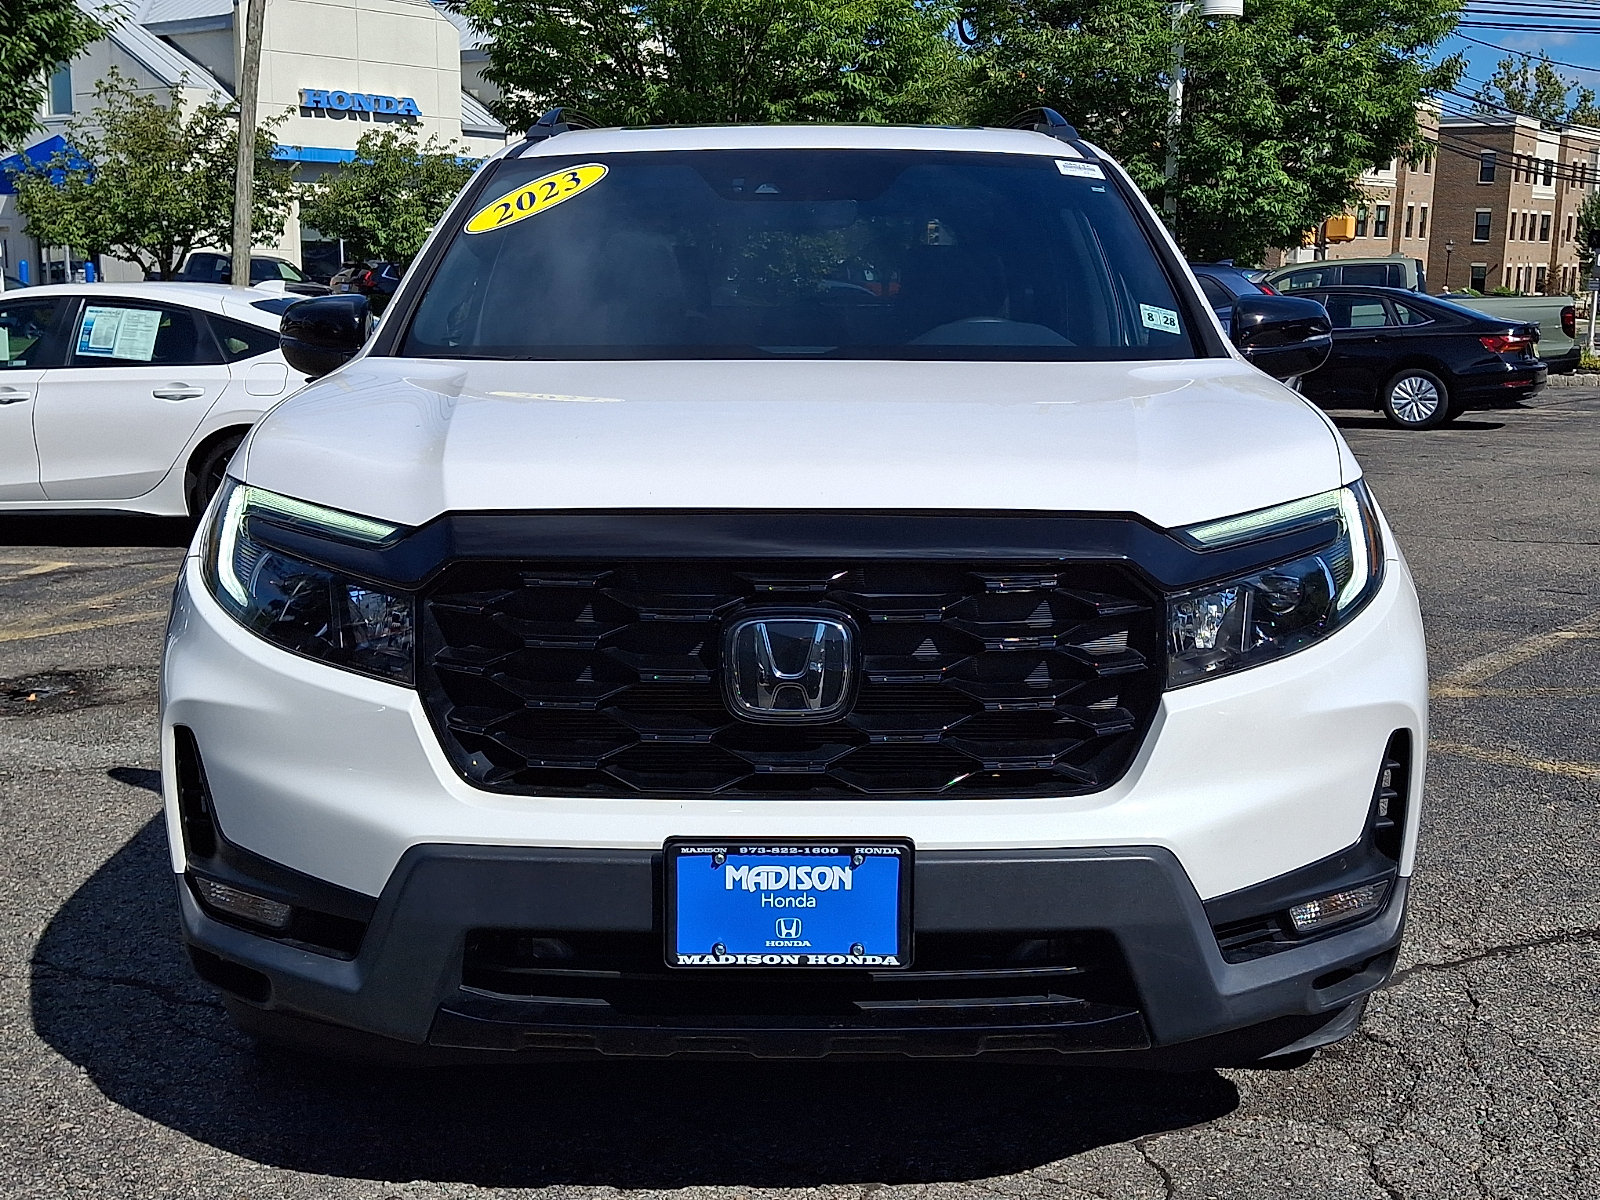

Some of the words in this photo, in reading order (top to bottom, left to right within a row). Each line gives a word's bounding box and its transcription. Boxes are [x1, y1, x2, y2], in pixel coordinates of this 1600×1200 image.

[302, 88, 422, 116] HONDA
[493, 171, 581, 224] 2023
[1147, 312, 1154, 322] 8
[1163, 315, 1176, 326] 28
[725, 865, 852, 892] MADISON
[761, 892, 816, 908] Honda
[677, 954, 799, 965] MADISON
[806, 954, 901, 966] HONDA
